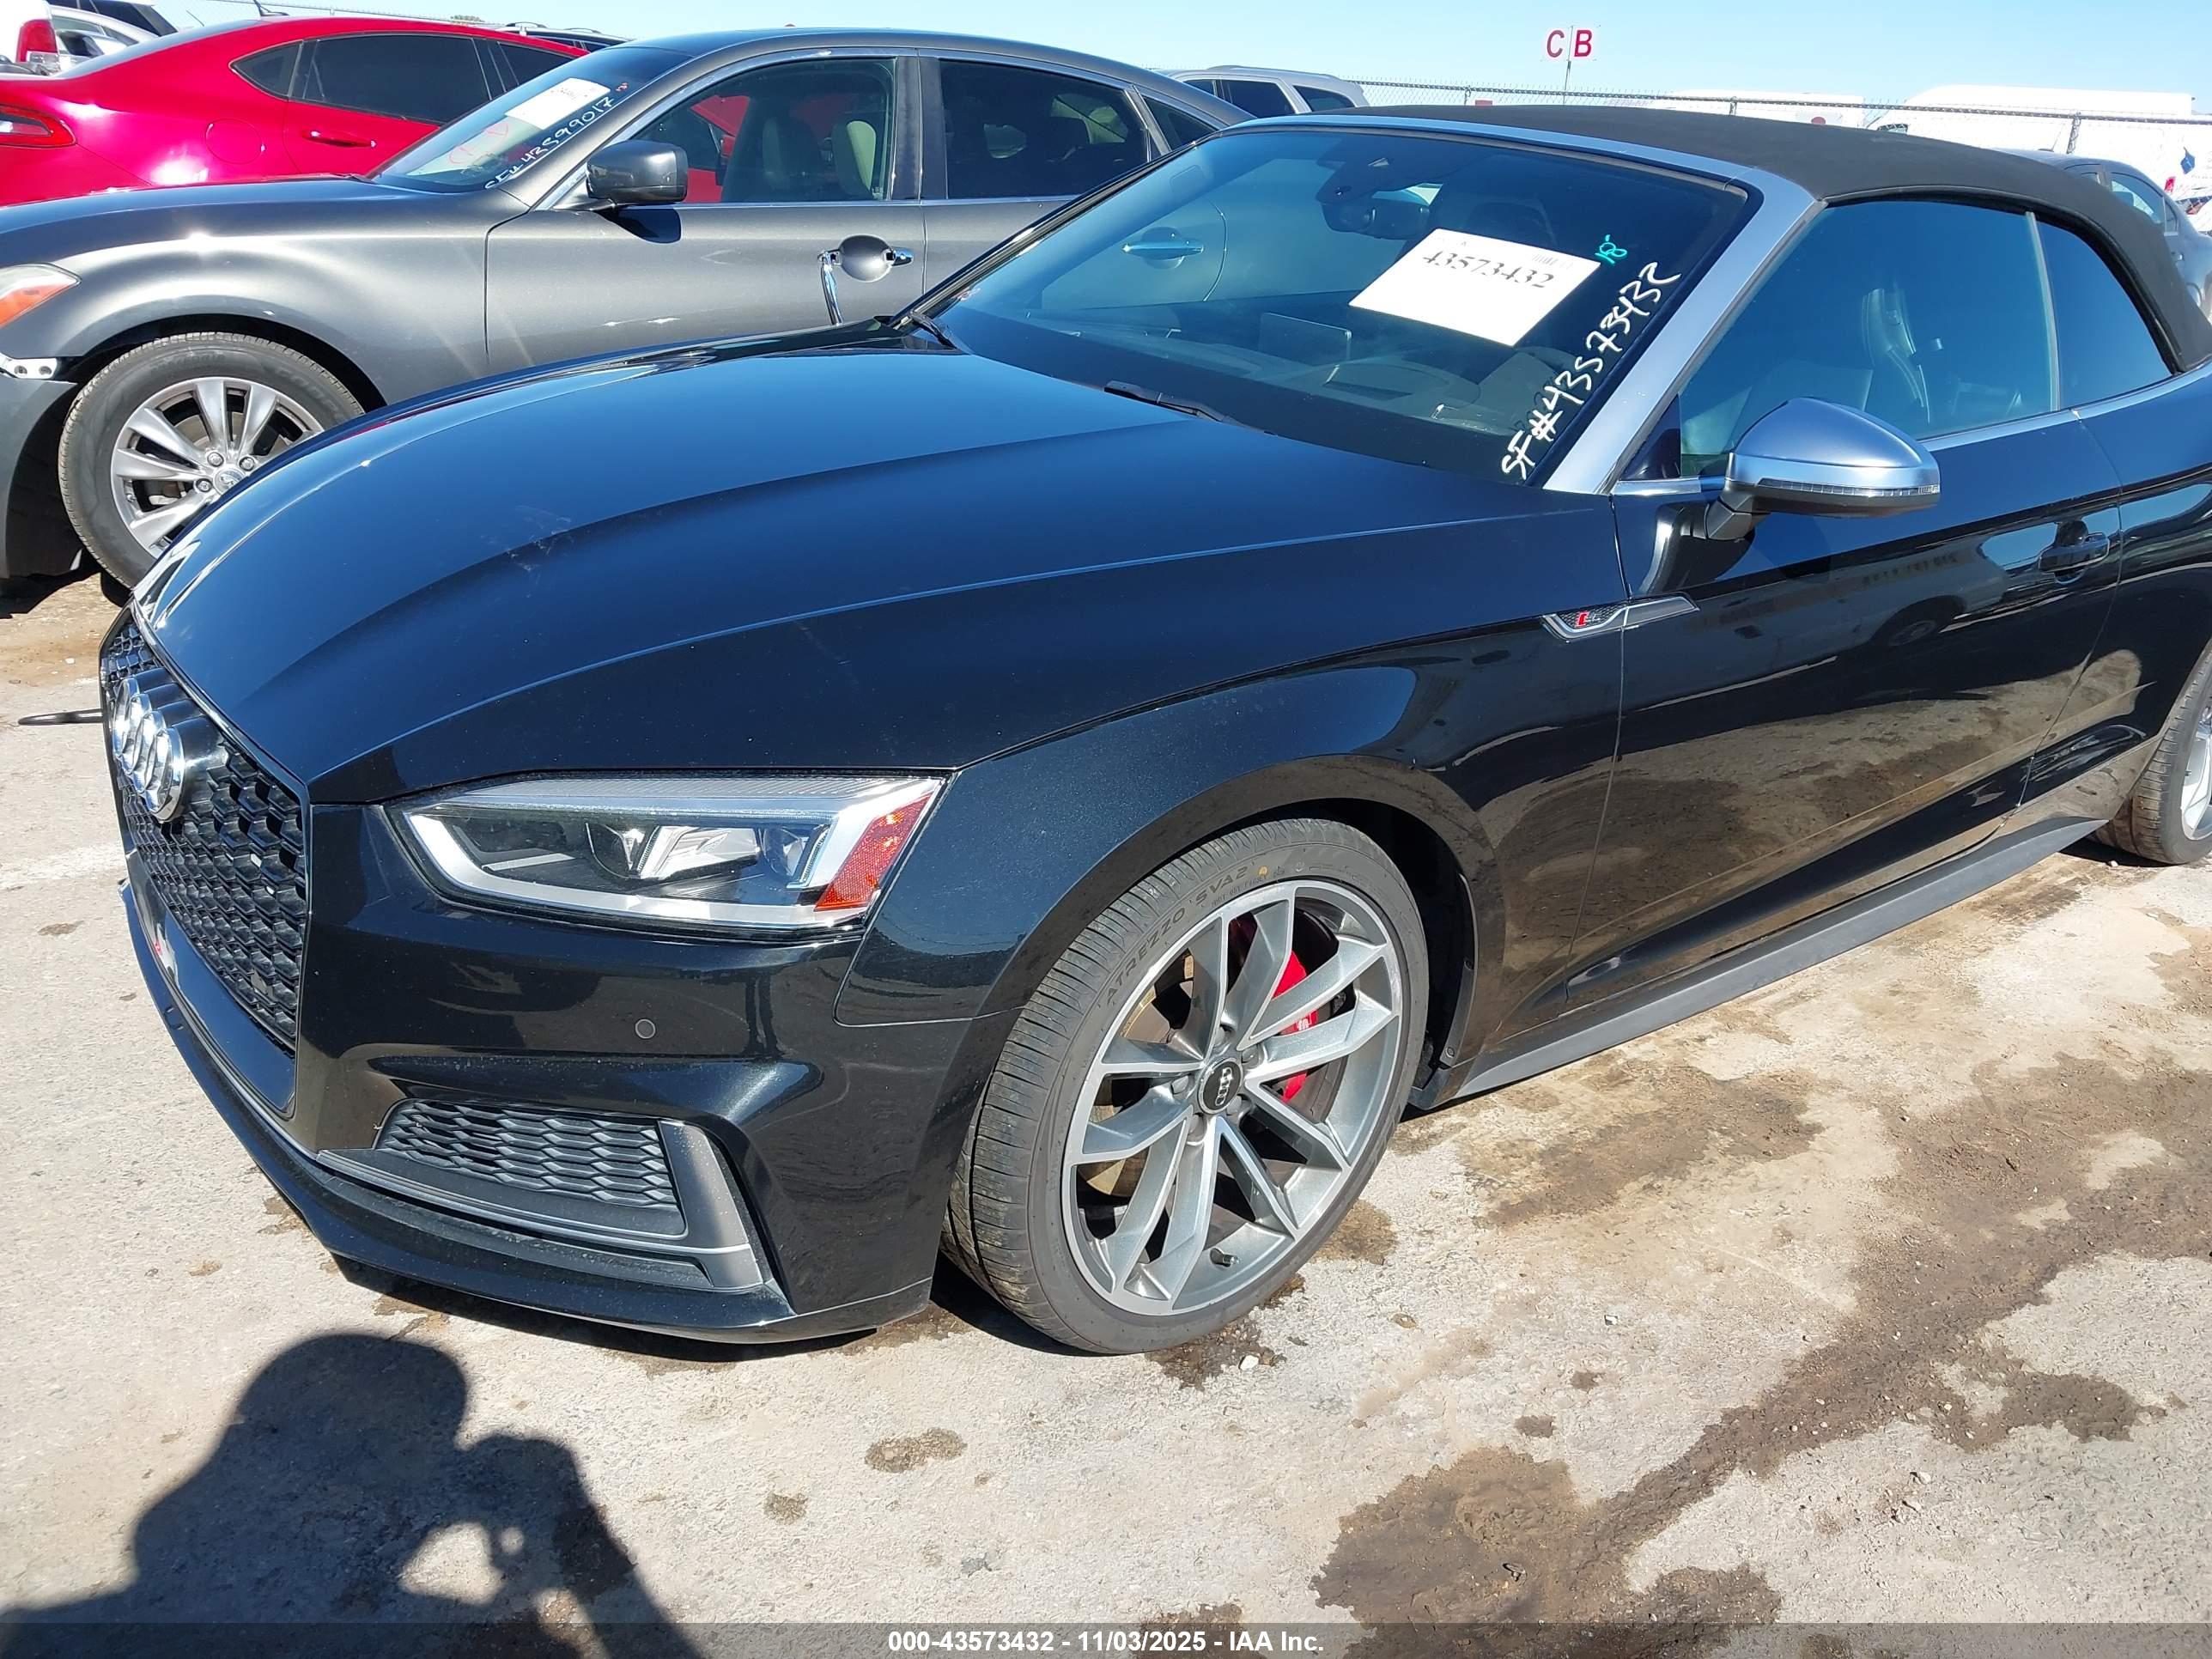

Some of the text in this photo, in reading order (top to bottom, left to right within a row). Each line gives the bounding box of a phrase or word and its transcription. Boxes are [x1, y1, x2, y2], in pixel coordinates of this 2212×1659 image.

[1547, 29, 1592, 58] C B
[1423, 250, 1555, 289] 43573432
